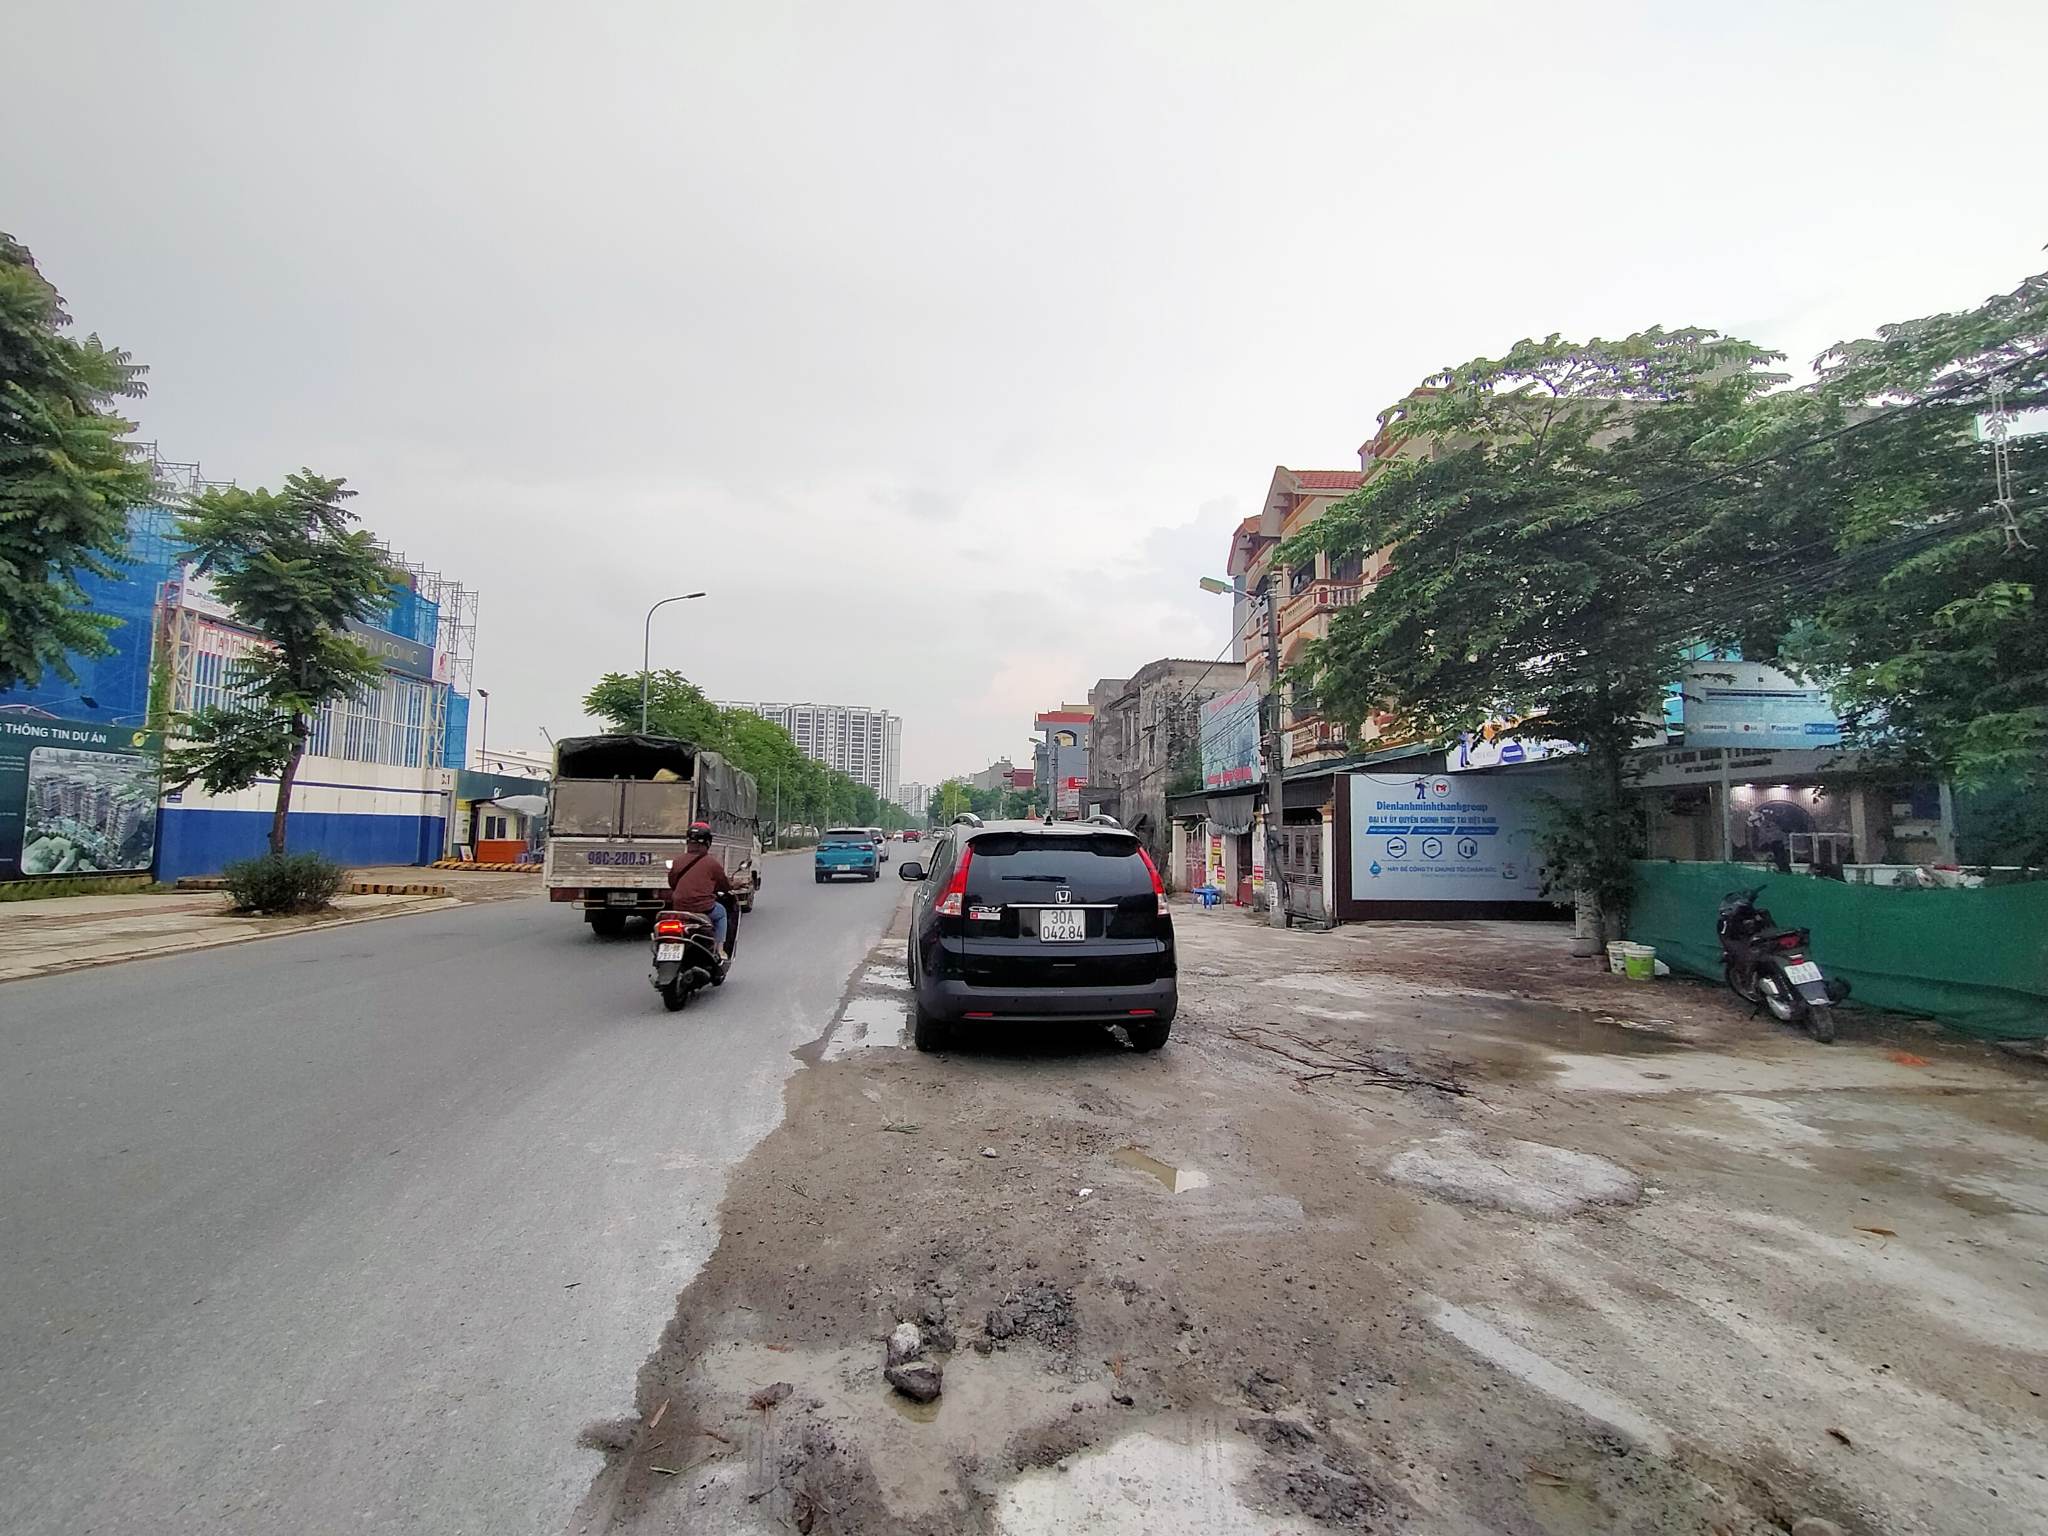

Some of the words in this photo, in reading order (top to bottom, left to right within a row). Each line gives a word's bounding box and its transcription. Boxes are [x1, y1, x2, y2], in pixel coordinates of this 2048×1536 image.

[5, 722, 49, 738] THÔNG
[51, 728, 70, 740] TIN
[72, 730, 90, 743] DỰ
[91, 731, 107, 744] ÁN
[1376, 801, 1488, 812] Dienlanhminhthanhgroup
[588, 851, 652, 865] 98C-280.51
[1051, 911, 1075, 924] 30A
[1043, 926, 1083, 940] 042.84
